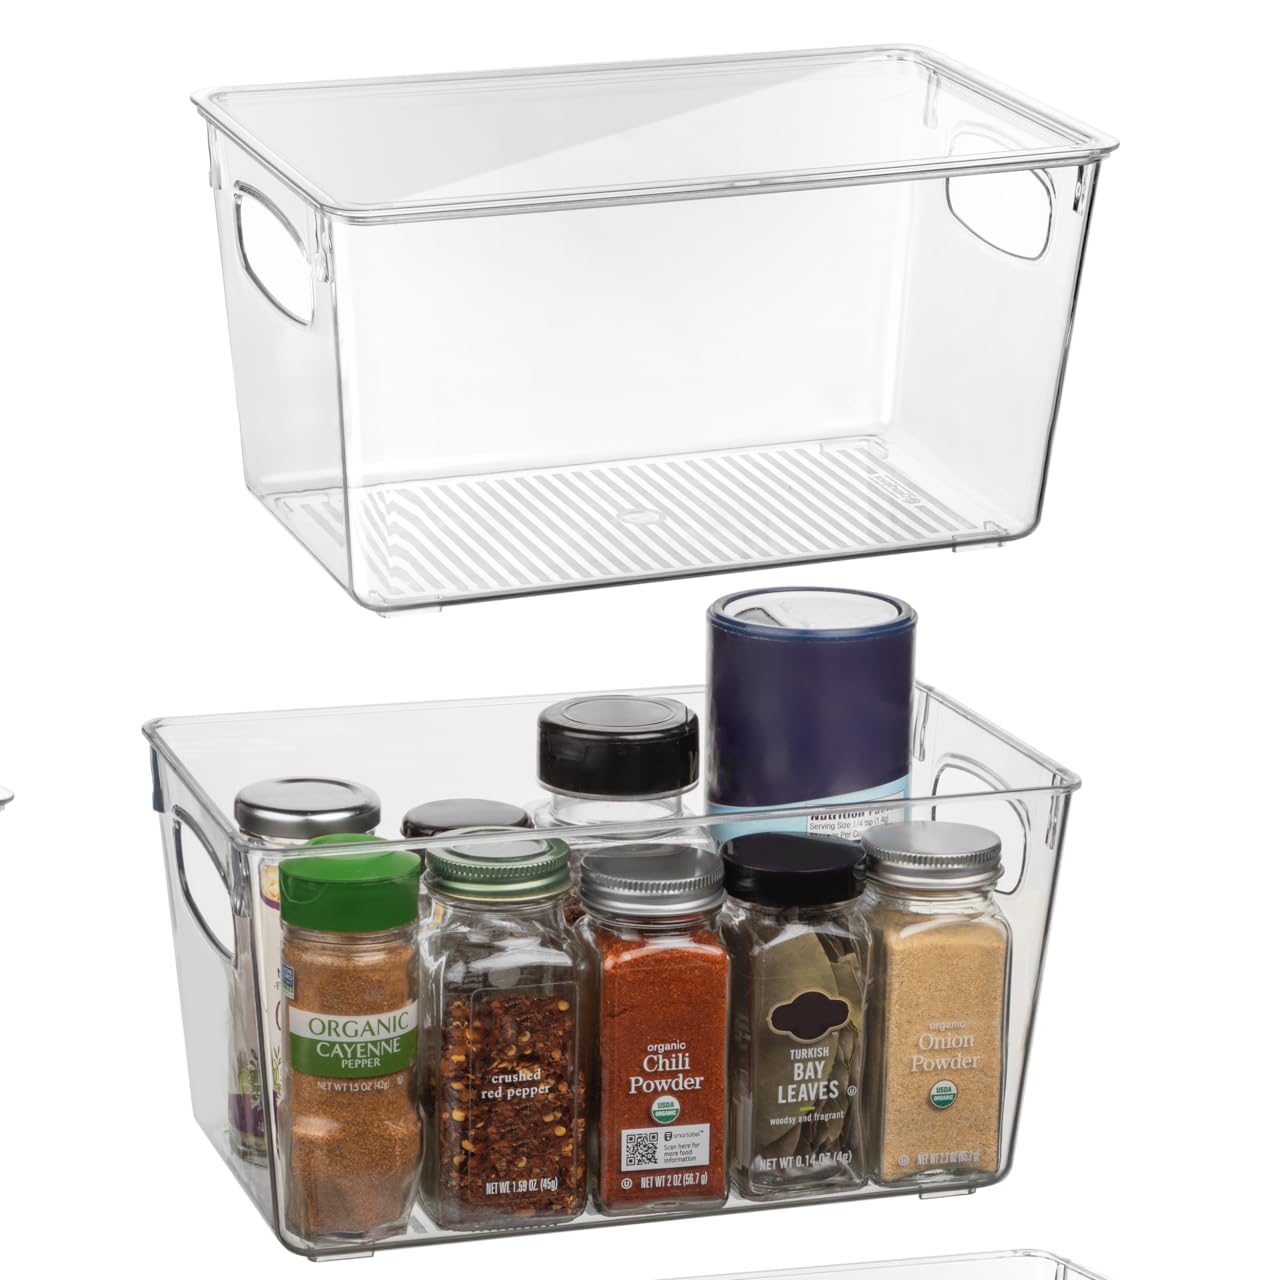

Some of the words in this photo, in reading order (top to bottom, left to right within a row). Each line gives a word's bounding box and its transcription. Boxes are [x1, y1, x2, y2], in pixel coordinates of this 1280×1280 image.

[809, 822, 836, 833] Serving
[837, 821, 851, 830] Size
[308, 1011, 409, 1038] ORGANIC
[928, 1019, 967, 1032] organic
[316, 1037, 401, 1059] CAYENNE
[647, 1040, 687, 1054] organic
[918, 1032, 976, 1051] Onion
[790, 1046, 830, 1061] TURKISH
[341, 1058, 381, 1069] PEPPER
[642, 1053, 691, 1073] Chili
[793, 1060, 825, 1081] BAY
[910, 1053, 981, 1073] Powder
[491, 1068, 542, 1085] crushed
[628, 1073, 705, 1094] Powder
[317, 1081, 333, 1090] NET
[334, 1082, 348, 1092] WT
[481, 1084, 503, 1099] red
[505, 1084, 552, 1100] pepper
[777, 1080, 839, 1105] LEAVES
[936, 1086, 952, 1094] USDA
[657, 1101, 675, 1109] USDA
[770, 1114, 796, 1126] woodsy
[798, 1113, 812, 1123] and
[814, 1110, 845, 1123] fragrant
[663, 1156, 697, 1164] information
[759, 1156, 778, 1171] NET
[778, 1155, 794, 1169] WT
[795, 1154, 816, 1168] 0.14
[832, 1150, 852, 1164] (4g)
[486, 1182, 498, 1195] NET
[512, 1180, 527, 1193] 1.59
[540, 1177, 558, 1192] (45g)
[640, 1176, 654, 1189] NET
[654, 1175, 666, 1188] WT
